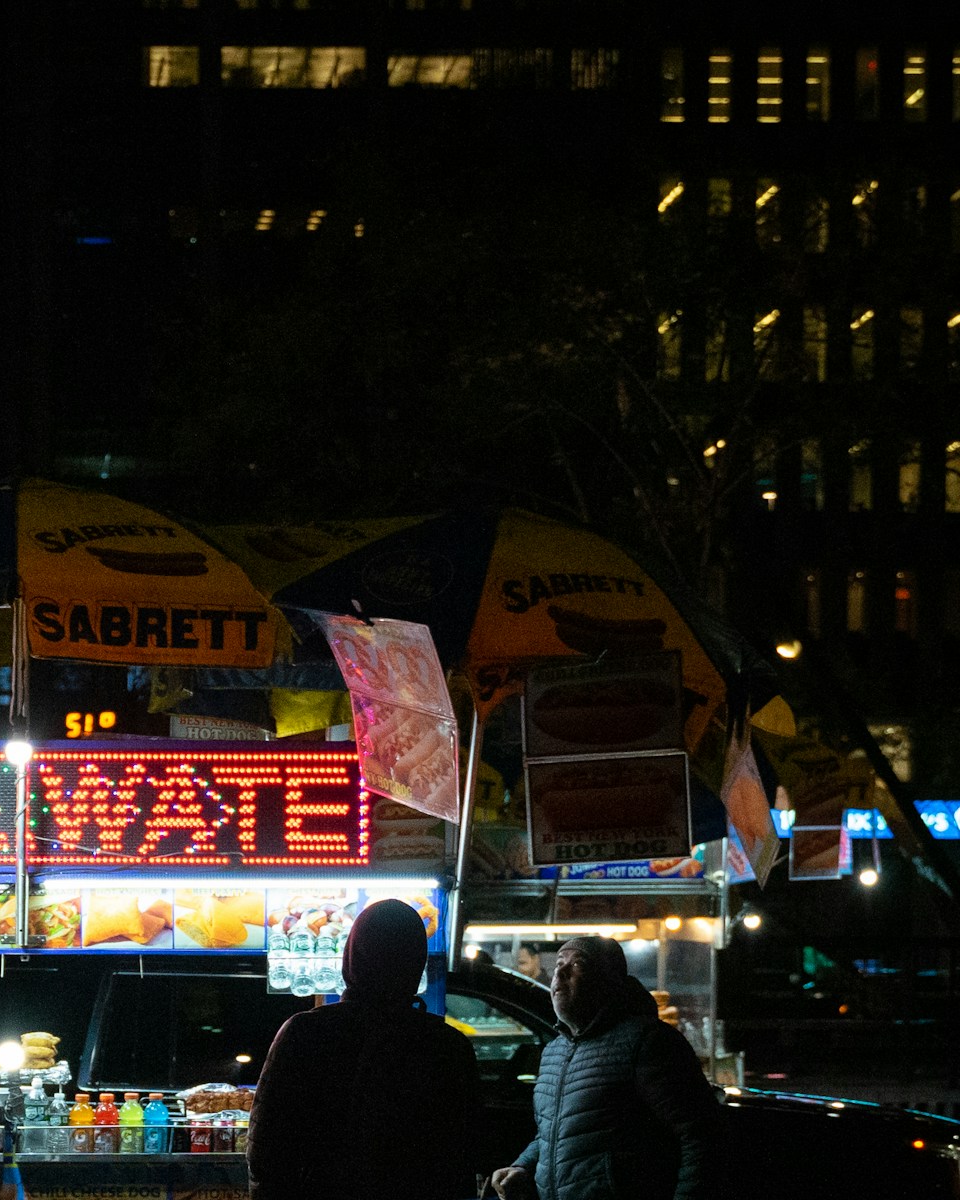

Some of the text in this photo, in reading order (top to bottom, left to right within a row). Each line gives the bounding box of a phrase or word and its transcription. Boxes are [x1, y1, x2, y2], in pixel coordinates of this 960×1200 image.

[35, 523, 178, 553] SABRETT
[502, 572, 645, 614] SABRETT
[33, 601, 269, 651] SABRETT
[187, 726, 222, 740] HOT
[554, 838, 668, 860] HOT DOG
[606, 866, 649, 878] HOT DOG
[71, 1185, 125, 1199] CHEESE
[128, 1185, 161, 1199] DOG
